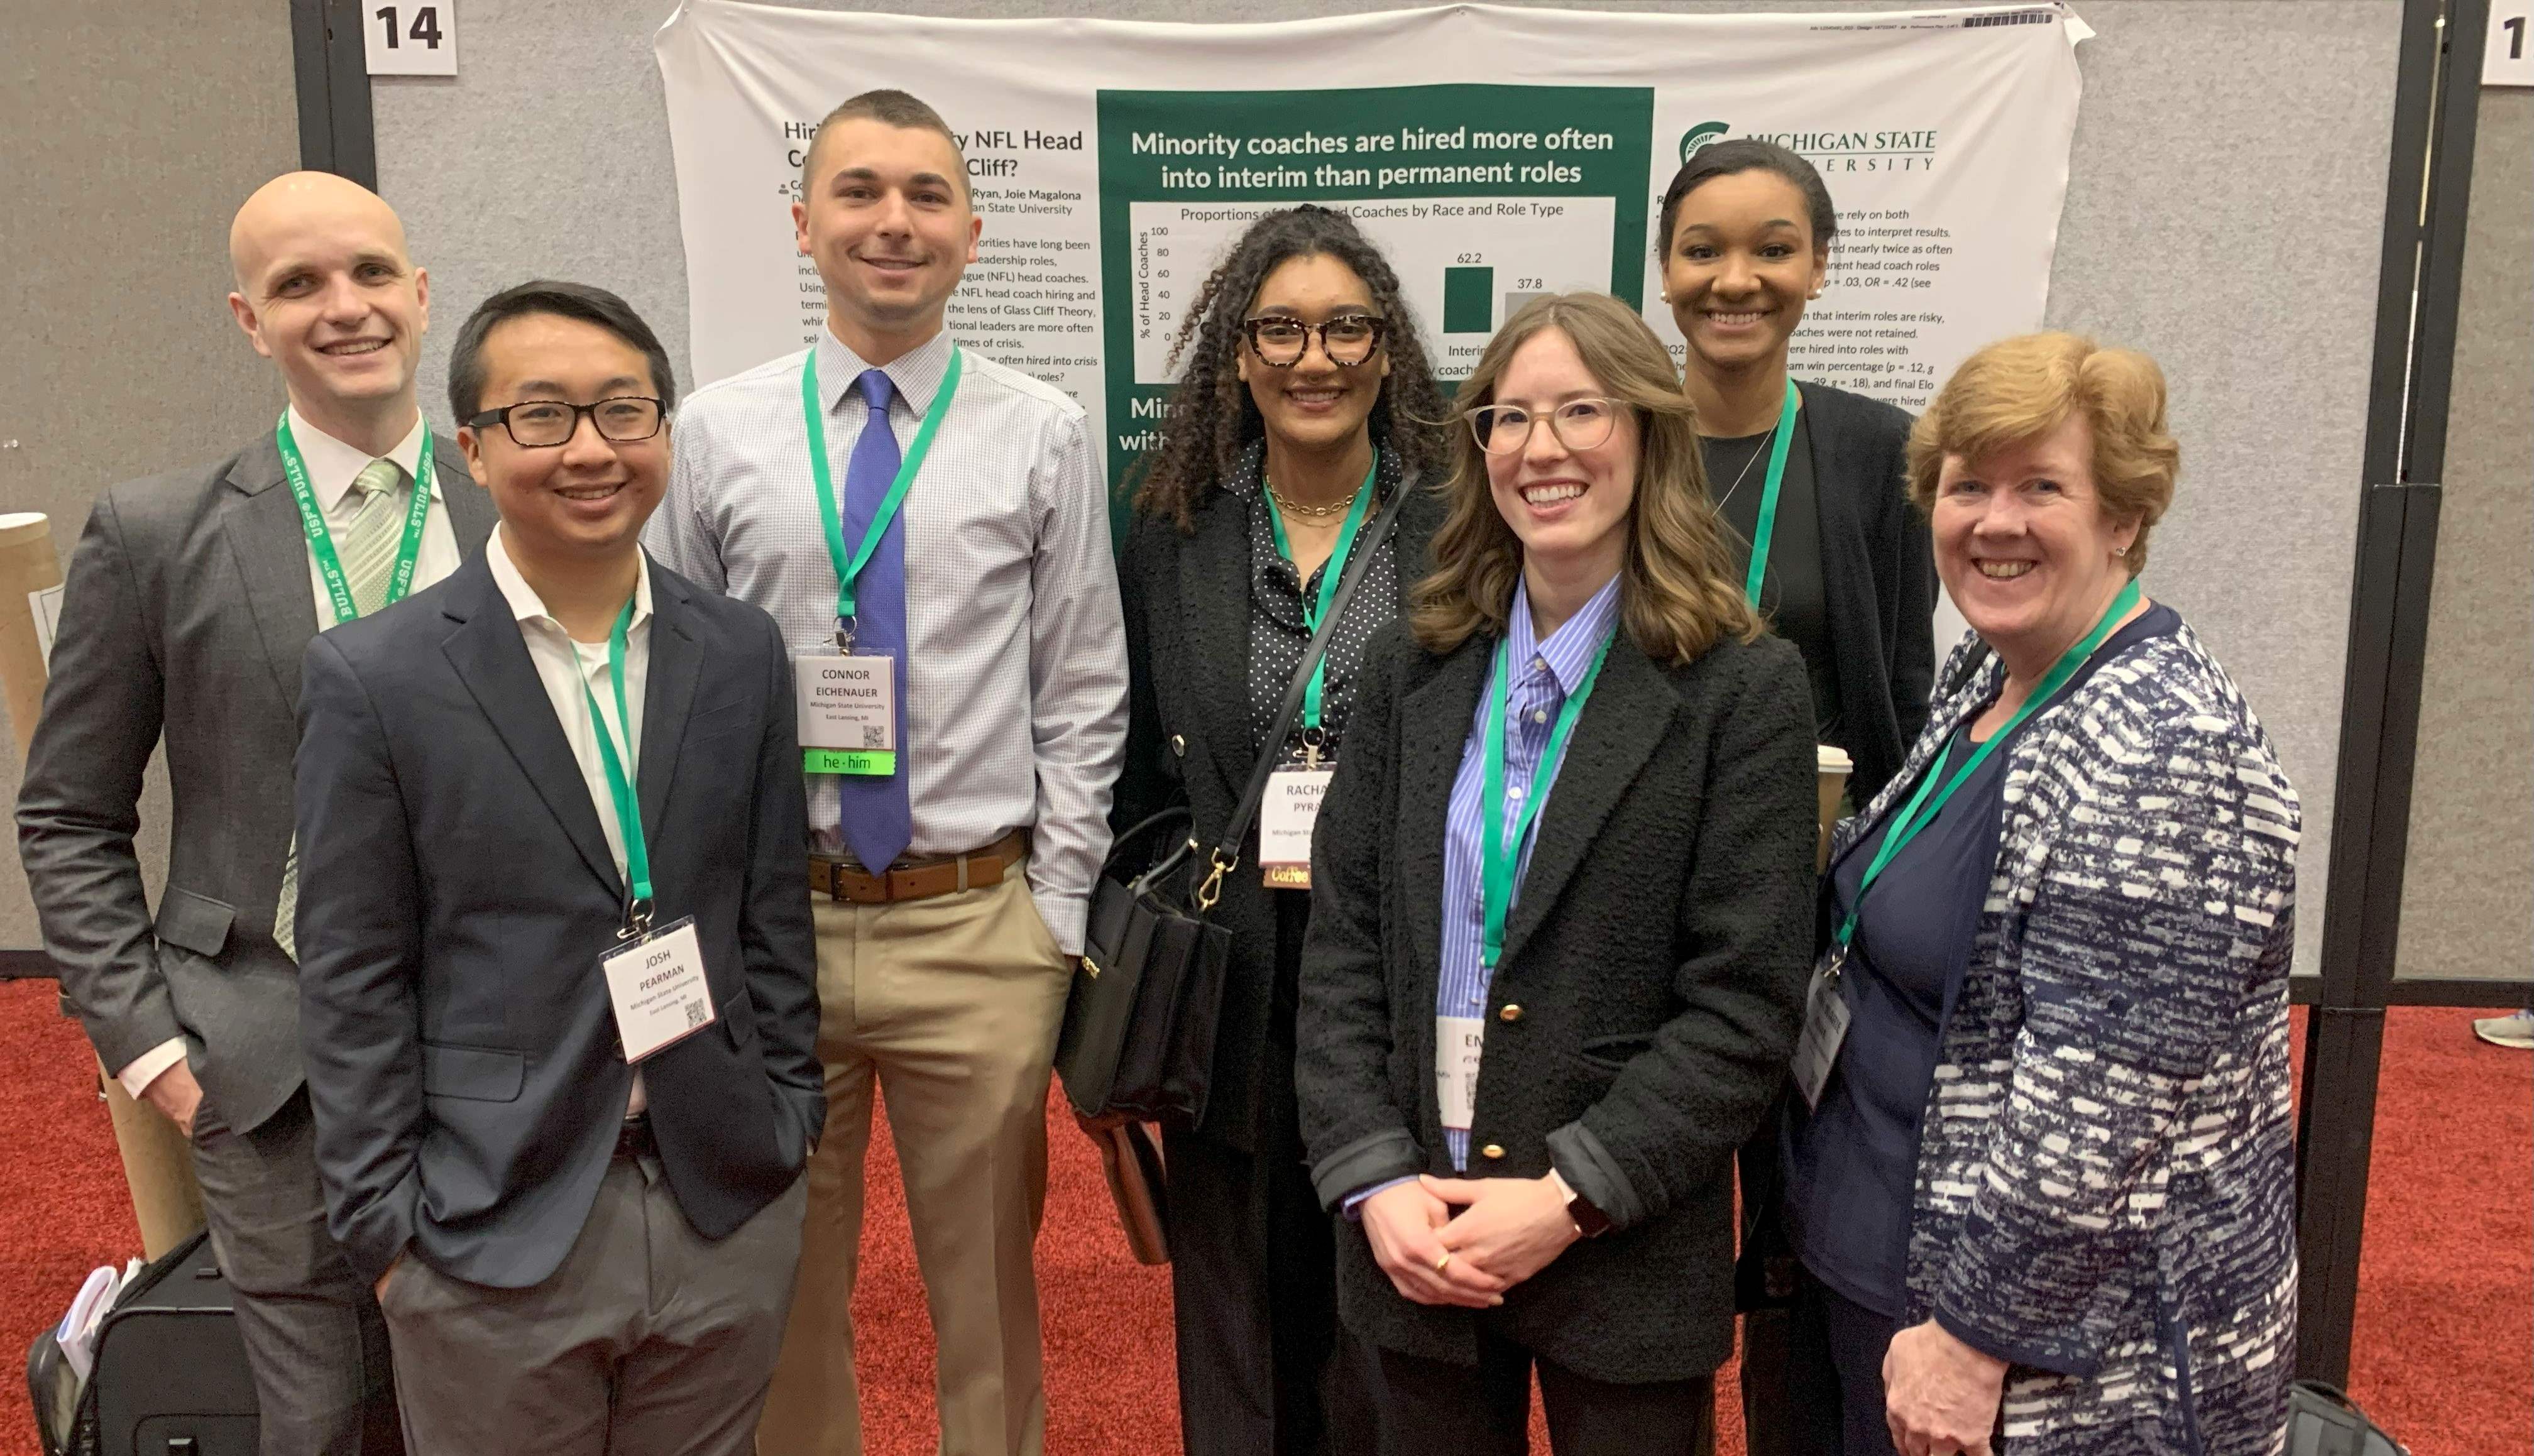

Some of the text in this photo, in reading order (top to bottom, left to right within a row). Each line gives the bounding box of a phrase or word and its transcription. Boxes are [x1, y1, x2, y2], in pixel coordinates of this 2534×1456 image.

[376, 7, 442, 49] 14
[2504, 17, 2525, 59] 1
[785, 121, 820, 140] Hir
[976, 131, 1017, 148] NFL
[1024, 130, 1082, 150] Head
[1133, 126, 1613, 159] Minority coaches are hired more often
[1875, 131, 1936, 149] STATE
[967, 159, 1017, 177] Cliff?
[1162, 160, 1581, 189] into interim than permanent roles
[973, 189, 1081, 201] Ryan, Joie Magalona
[989, 203, 1015, 212] State
[1019, 204, 1072, 216] University
[1181, 207, 1259, 223] Proportions
[1352, 205, 1408, 218] Coaches
[1413, 205, 1428, 219] by
[1433, 204, 1464, 216] Race
[1469, 204, 1492, 215] and
[1498, 204, 1525, 215] Role
[1530, 204, 1563, 217] Type
[1847, 210, 1867, 221] rely
[1885, 210, 1909, 219] both
[1855, 227, 1950, 238] to interpret results.
[977, 238, 1090, 251] orities have long been
[1848, 244, 1879, 255] nearly
[1883, 244, 1909, 253] twice
[1926, 244, 1952, 254] often
[1157, 248, 1169, 256] 80
[1457, 253, 1481, 263] 62.2
[976, 256, 1056, 266] eadership roles,
[1857, 261, 1939, 271] head coach roles
[987, 272, 1089, 283] (NFL) head coaches.
[1158, 270, 1169, 278] 60
[1138, 232, 1150, 338] % of Head Coaches
[1518, 278, 1542, 288] 37.8
[1843, 278, 1861, 288] .03,
[1865, 278, 1880, 287] OR
[1892, 278, 1908, 287] .42
[1911, 278, 1931, 288] (see
[962, 288, 982, 297] NFL
[986, 288, 1009, 298] head
[1013, 290, 1042, 298] coach
[1046, 290, 1074, 302] hiring
[1077, 291, 1095, 300] and
[948, 304, 1095, 318] the lens of Glass Cliff Theory,
[1159, 312, 1170, 320] 20
[1813, 311, 1833, 320] that
[1836, 311, 1870, 320] interim
[1874, 312, 1897, 321] roles
[1919, 312, 1944, 324] risky,
[980, 321, 1016, 331] leaders
[1067, 324, 1093, 332] often
[1875, 329, 1918, 338] retained.
[983, 339, 993, 347] of
[997, 339, 1024, 348] crisis.
[1809, 344, 1908, 354] hired into roles with
[999, 355, 1023, 367] often
[1026, 356, 1050, 364] hired
[1053, 356, 1071, 365] into
[1074, 357, 1097, 366] crisis
[1807, 361, 1824, 370] win
[1828, 363, 1884, 373] percentage
[1907, 363, 1924, 373] .12,
[1873, 379, 1892, 388] and
[1895, 379, 1915, 388] final
[1919, 380, 1933, 390] Elo
[1901, 397, 1926, 406] hired
[823, 670, 869, 679] CONNOR
[816, 687, 877, 697] EICHENAUER
[824, 755, 870, 769] he him
[1272, 866, 1308, 883] Coffee
[646, 950, 671, 969] JOSH
[640, 965, 684, 991] PEARMAN
